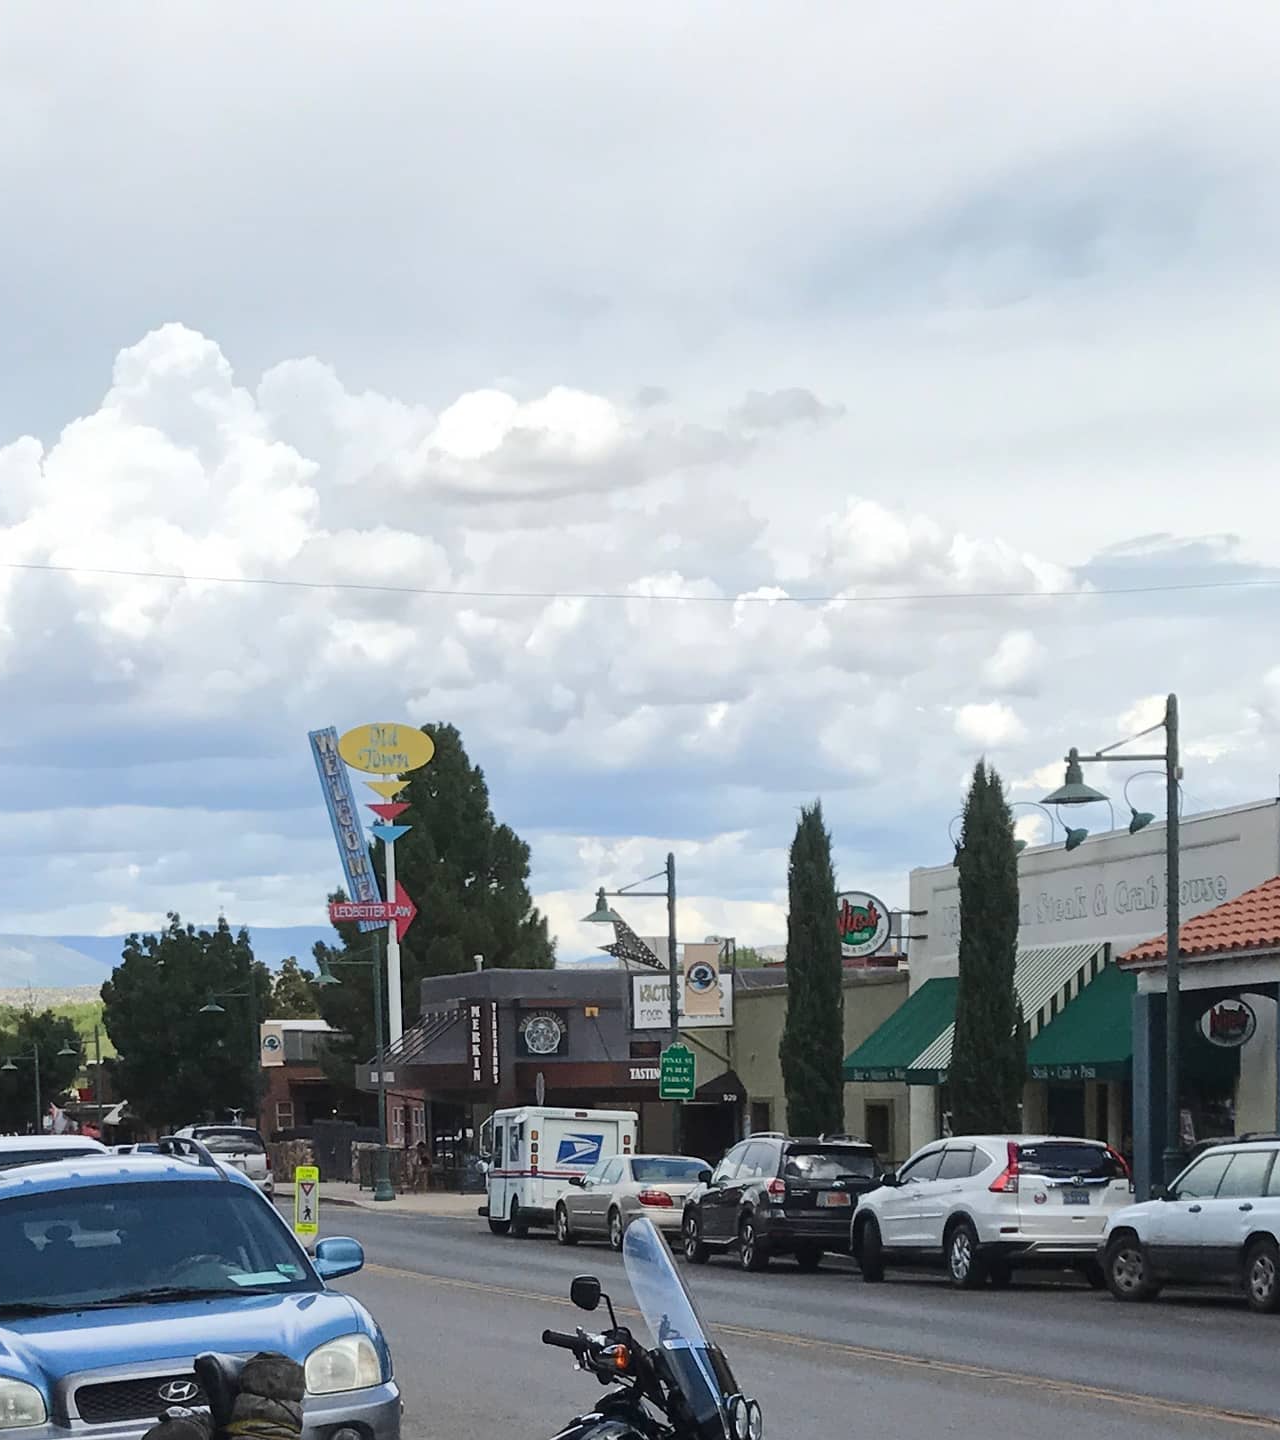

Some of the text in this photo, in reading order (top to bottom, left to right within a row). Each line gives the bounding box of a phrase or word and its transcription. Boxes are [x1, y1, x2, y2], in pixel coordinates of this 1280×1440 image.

[357, 747, 410, 769] Town
[314, 735, 375, 901] WELCOME
[334, 904, 411, 918] LEDBETTER LAW
[1036, 886, 1088, 922] Steak
[1114, 875, 1160, 914] Crab
[1164, 873, 1228, 910] ouse
[471, 1006, 481, 1081] MERKIN
[629, 1067, 662, 1080] TASTIN
